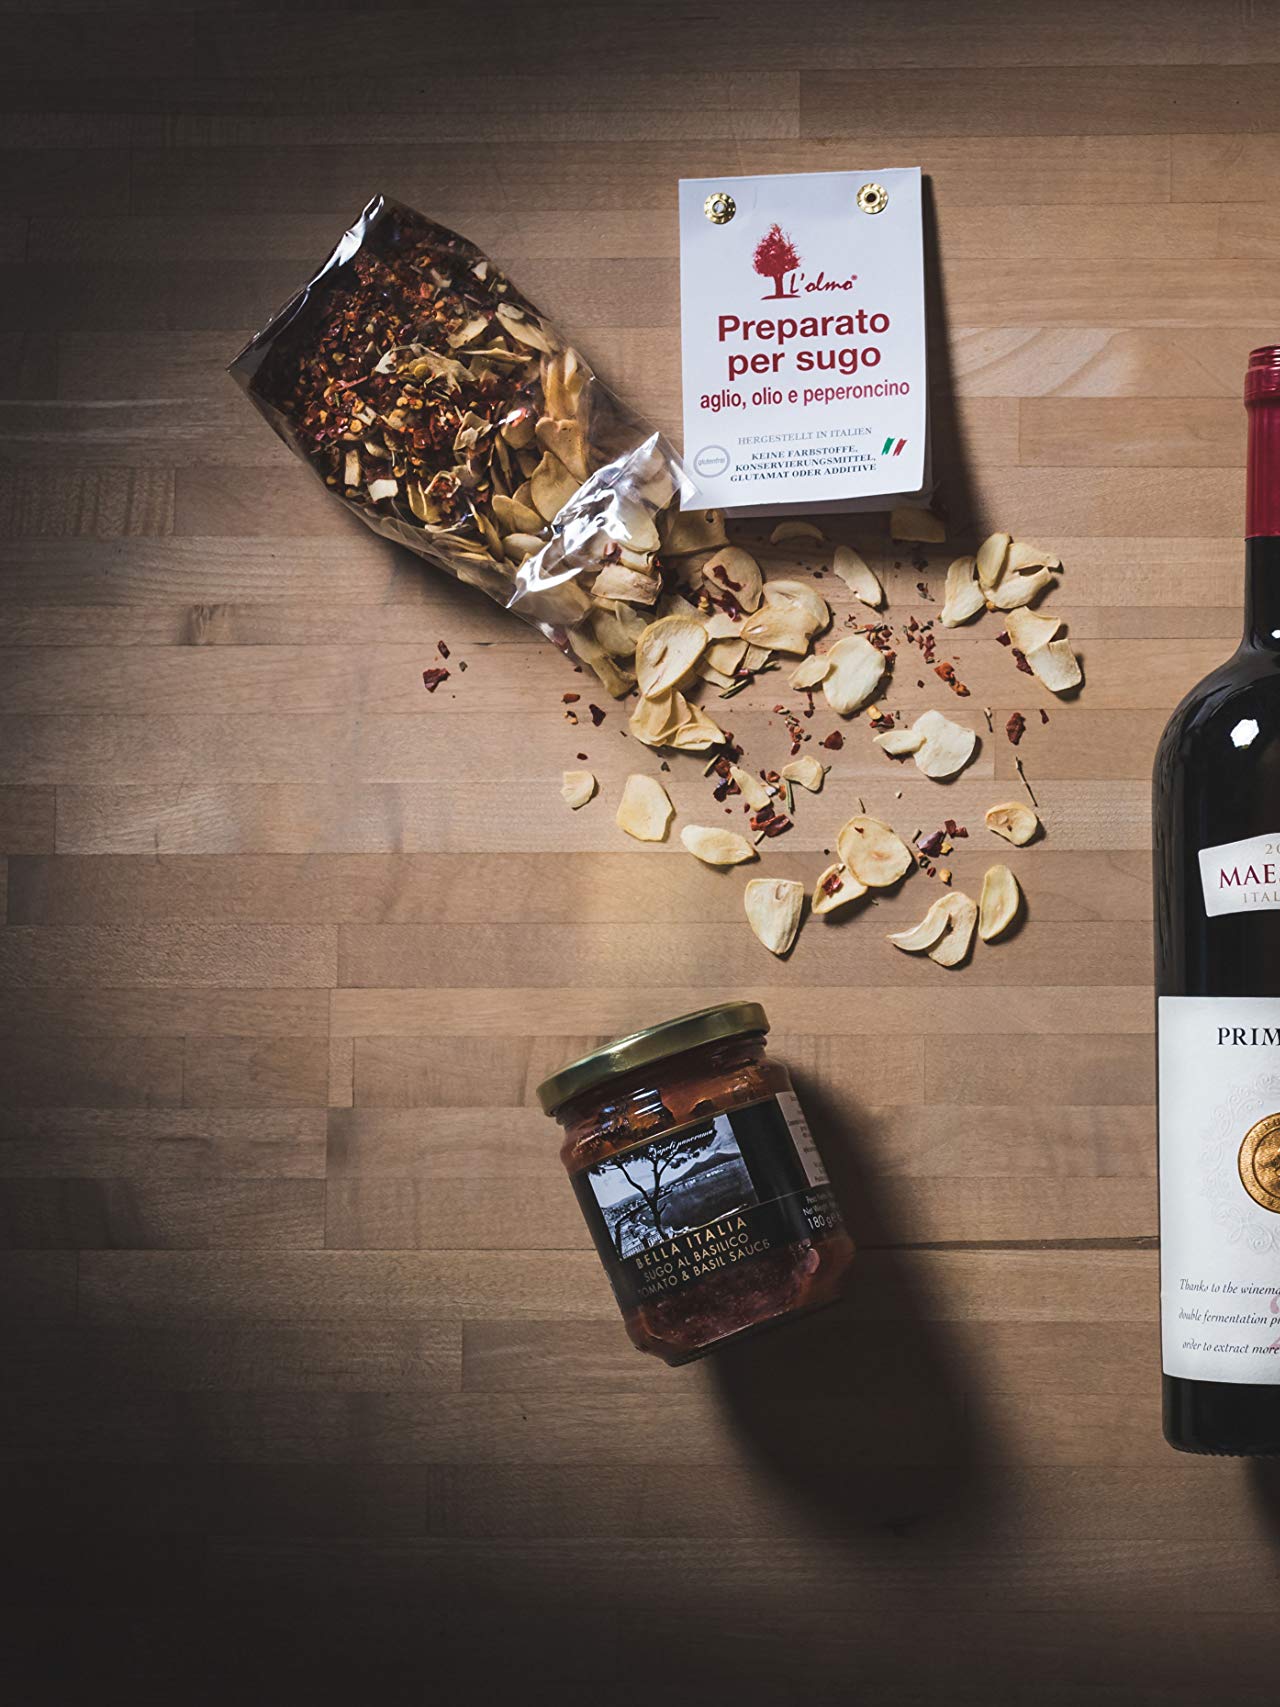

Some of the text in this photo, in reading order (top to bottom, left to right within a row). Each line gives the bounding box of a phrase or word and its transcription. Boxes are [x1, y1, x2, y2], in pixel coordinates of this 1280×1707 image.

[718, 309, 890, 345] Preparato
[728, 346, 881, 381] per sugo
[700, 379, 910, 413] aglio, olio e peperoncino
[738, 427, 872, 445] HERGESTELLT IN ITALIEN
[751, 445, 858, 461] KEINE FARBSTOFFE,
[735, 454, 876, 472] KONSERVIERUNGSMITTEL,
[730, 464, 877, 482] GLUTAMAT ODER ADDITIVE
[807, 1214, 825, 1230] 180
[635, 1217, 747, 1269] BELLA ITALIA
[644, 1233, 748, 1282] SUGO AL BASILICO
[637, 1239, 770, 1297] OMATO & BASIL SAUCE
[1180, 1278, 1208, 1292] Thanks
[1211, 1282, 1220, 1293] to
[1222, 1282, 1238, 1294] the
[1178, 1307, 1202, 1321] double
[1202, 1310, 1267, 1326] fermentation
[1182, 1338, 1202, 1350] order
[1203, 1340, 1212, 1351] to
[1214, 1343, 1249, 1354] extract
[1252, 1345, 1280, 1355] more
